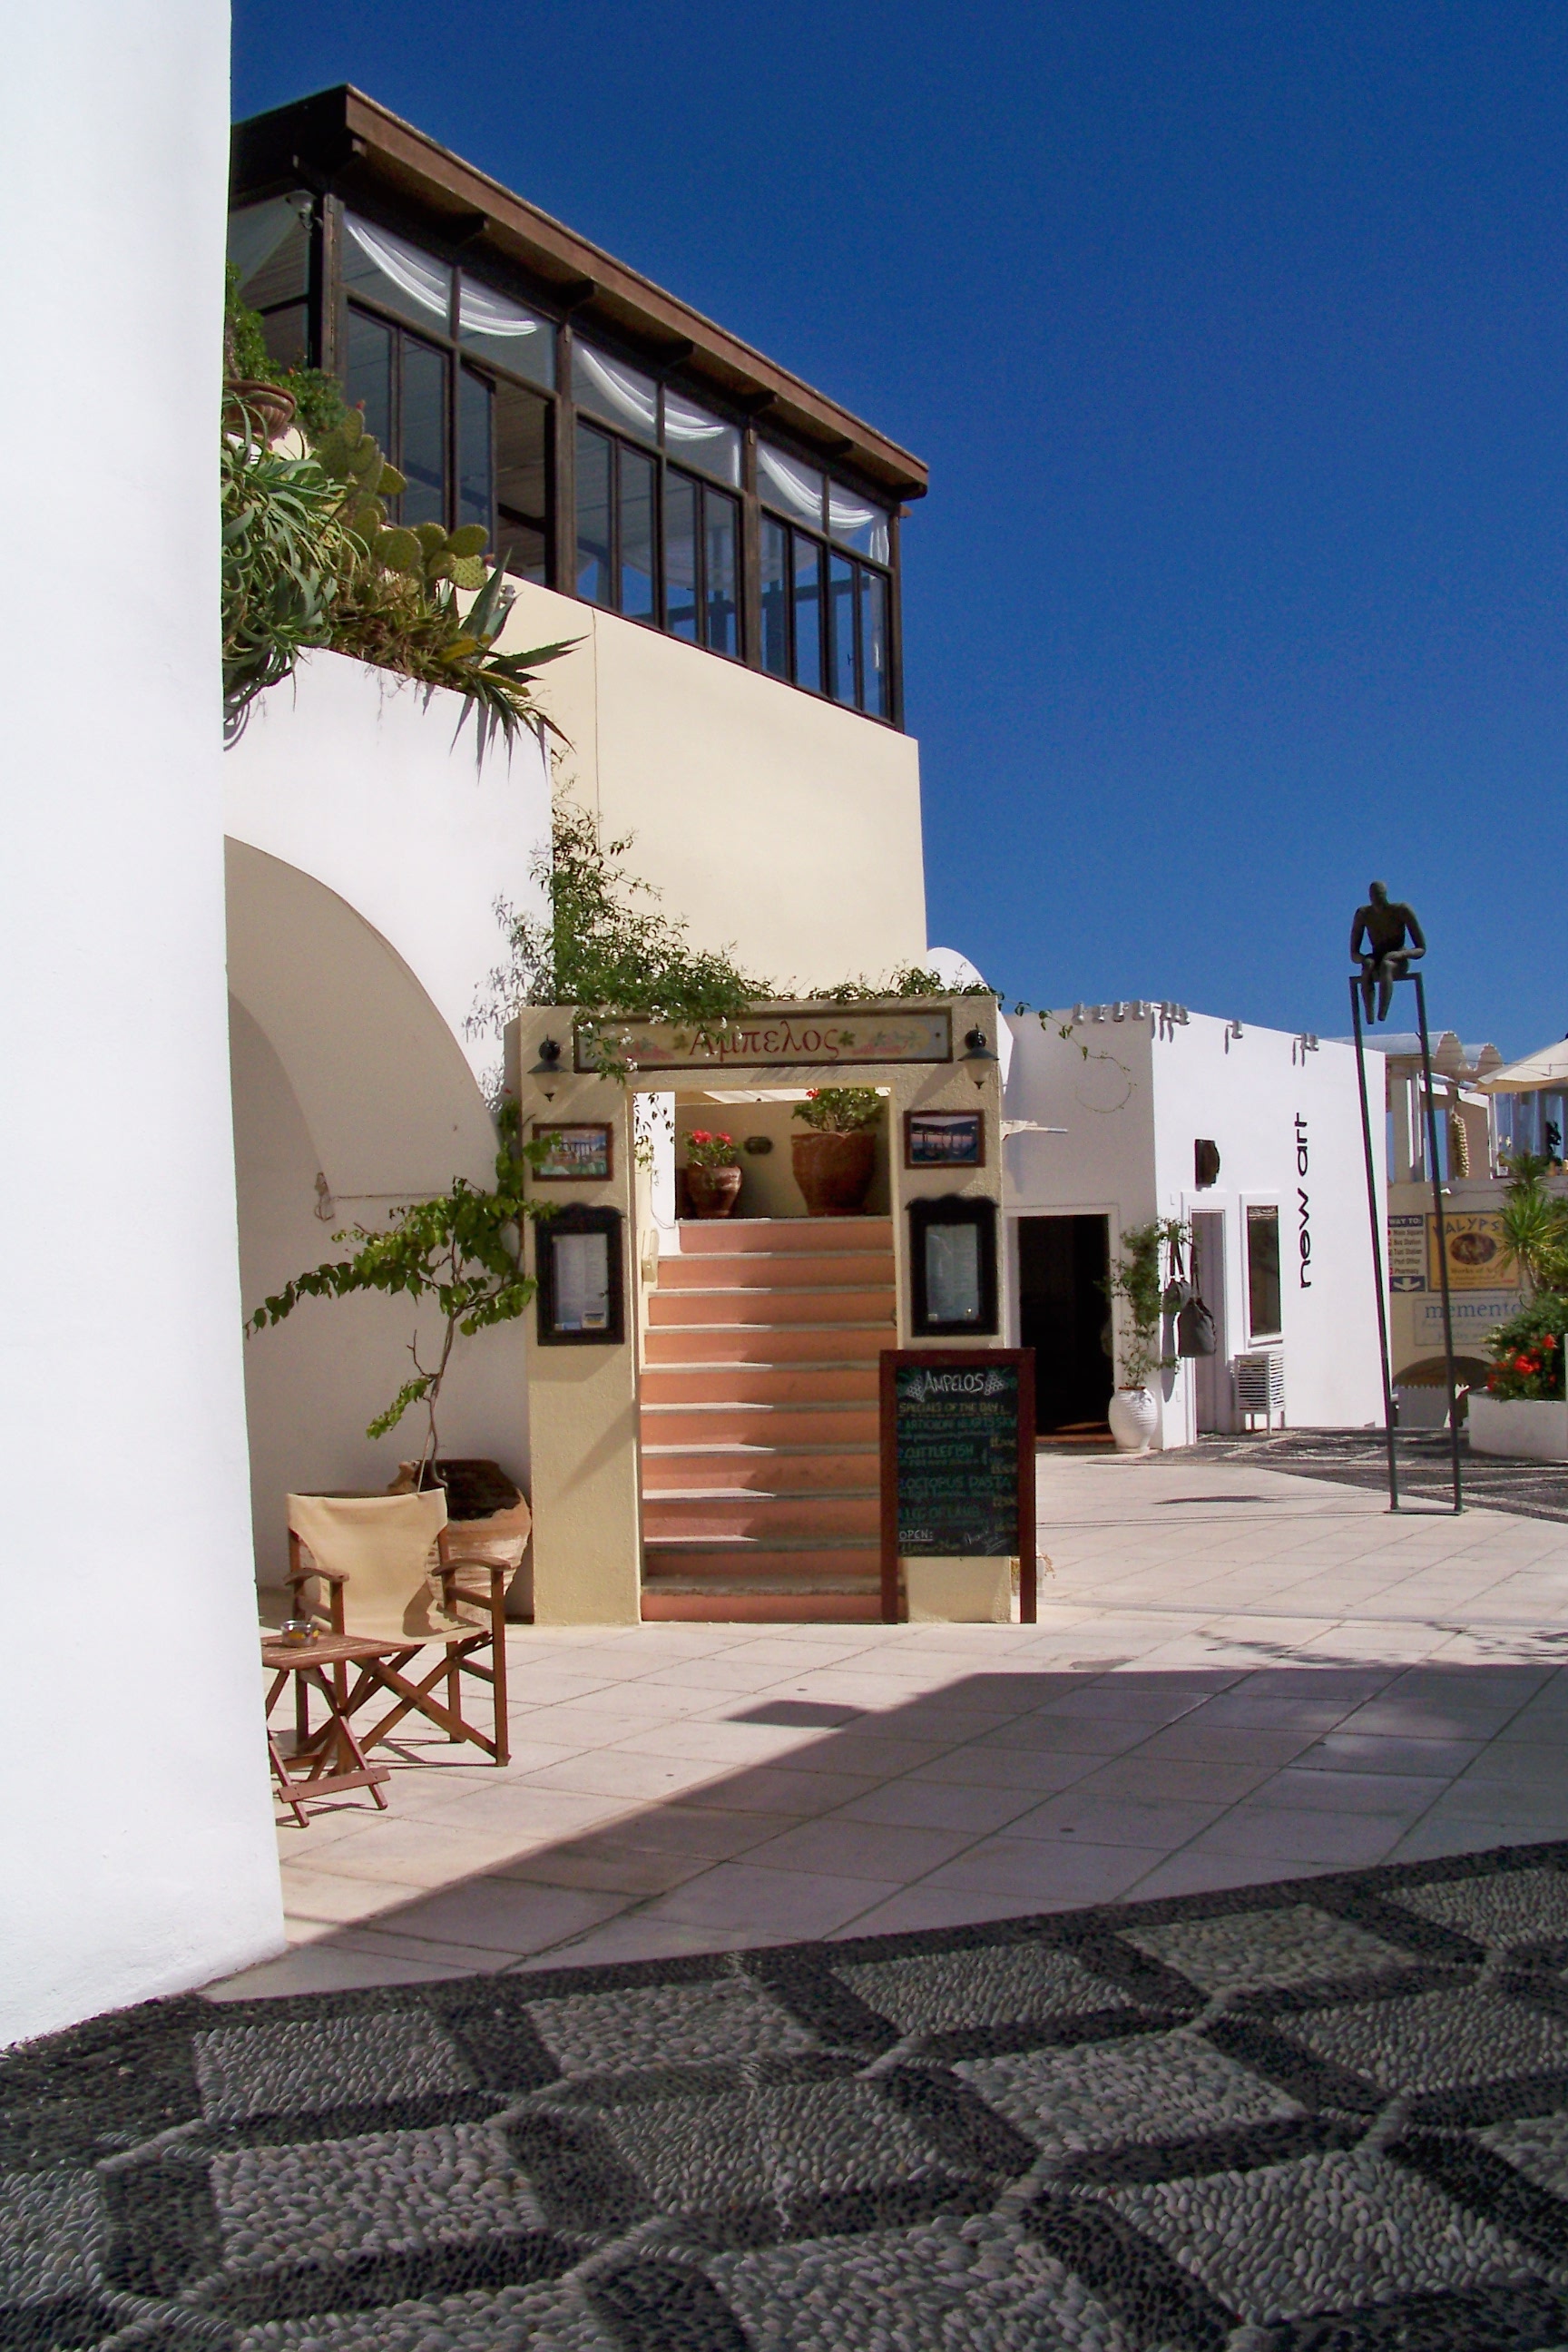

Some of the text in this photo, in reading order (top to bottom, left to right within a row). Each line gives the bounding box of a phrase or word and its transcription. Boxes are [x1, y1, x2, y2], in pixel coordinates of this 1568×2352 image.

[1294, 1112, 1312, 1289] new art
[924, 1369, 985, 1393] AMPELOS
